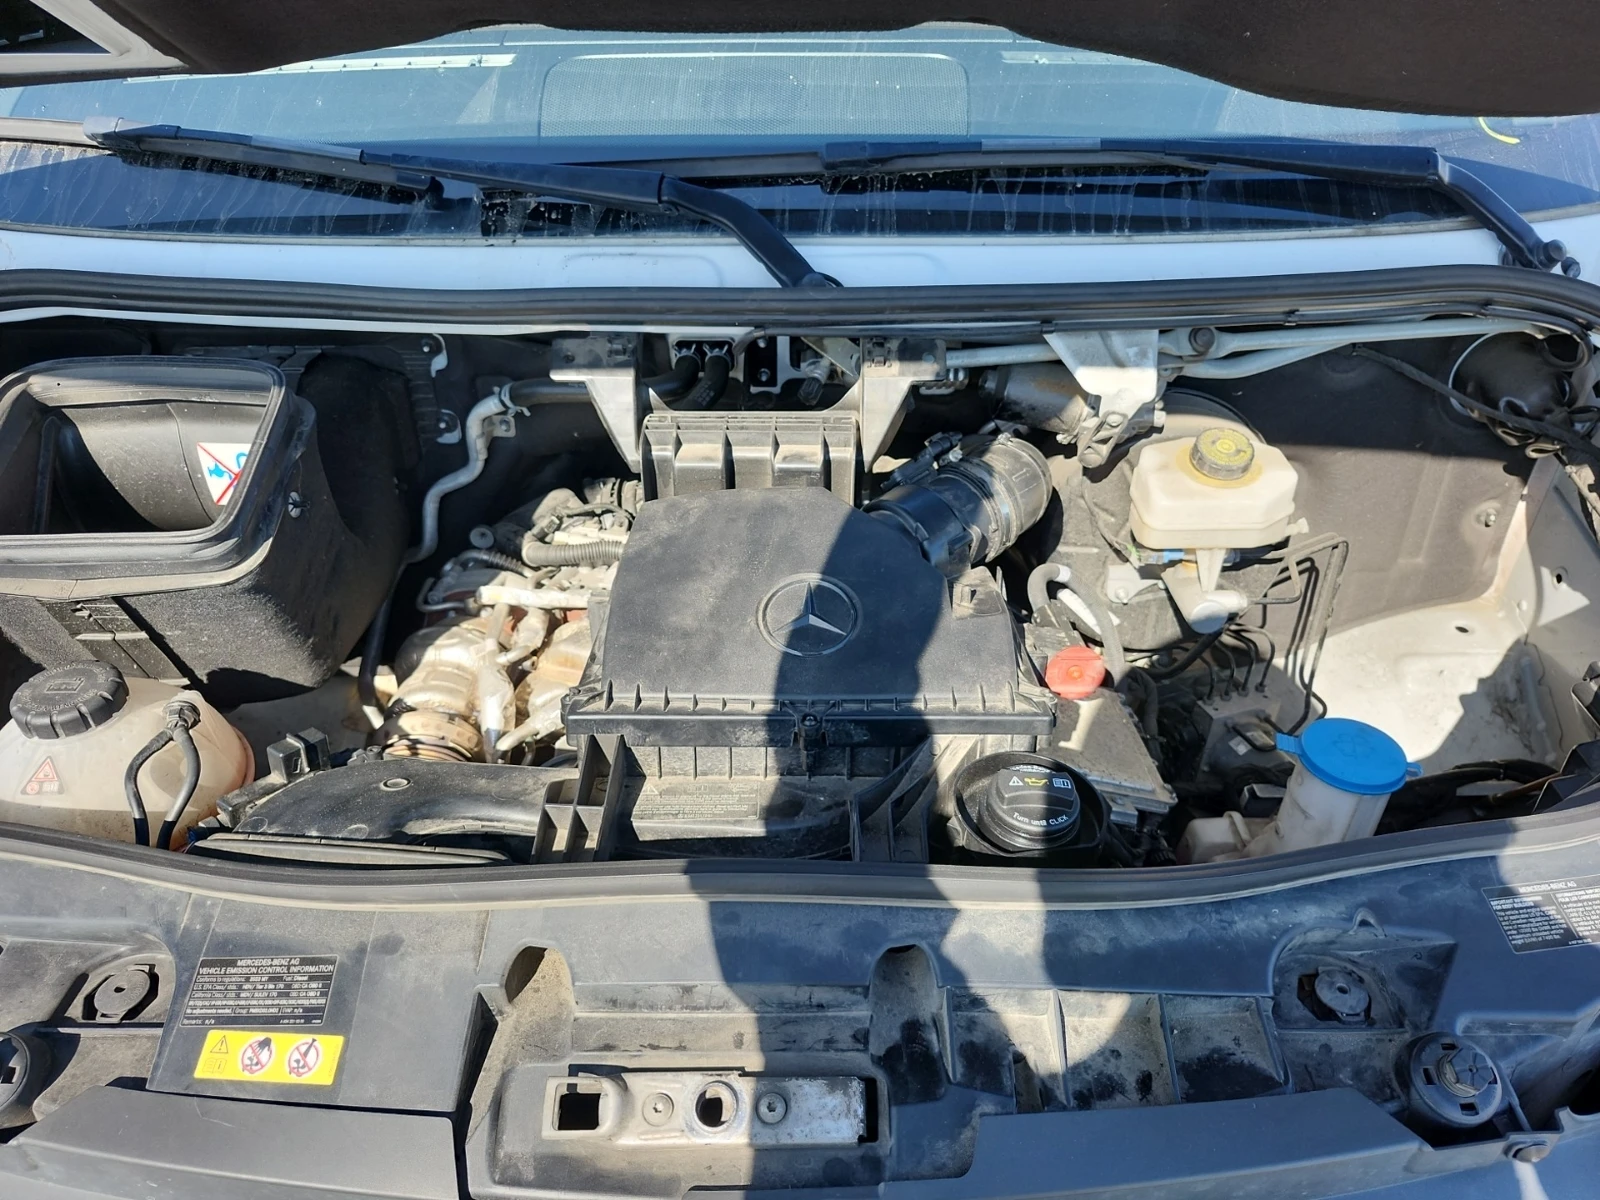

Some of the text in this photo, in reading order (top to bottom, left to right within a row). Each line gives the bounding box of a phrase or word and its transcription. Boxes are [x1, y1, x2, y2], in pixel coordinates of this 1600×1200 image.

[1012, 811, 1029, 823] Turn
[1049, 814, 1069, 825] CLICK
[1518, 881, 1567, 893] MERCEDES-BENZ
[237, 957, 300, 967] MERCEDES-BENZ AG
[199, 965, 335, 975] VEHICLE EMISSION CONTROL INFORMATION
